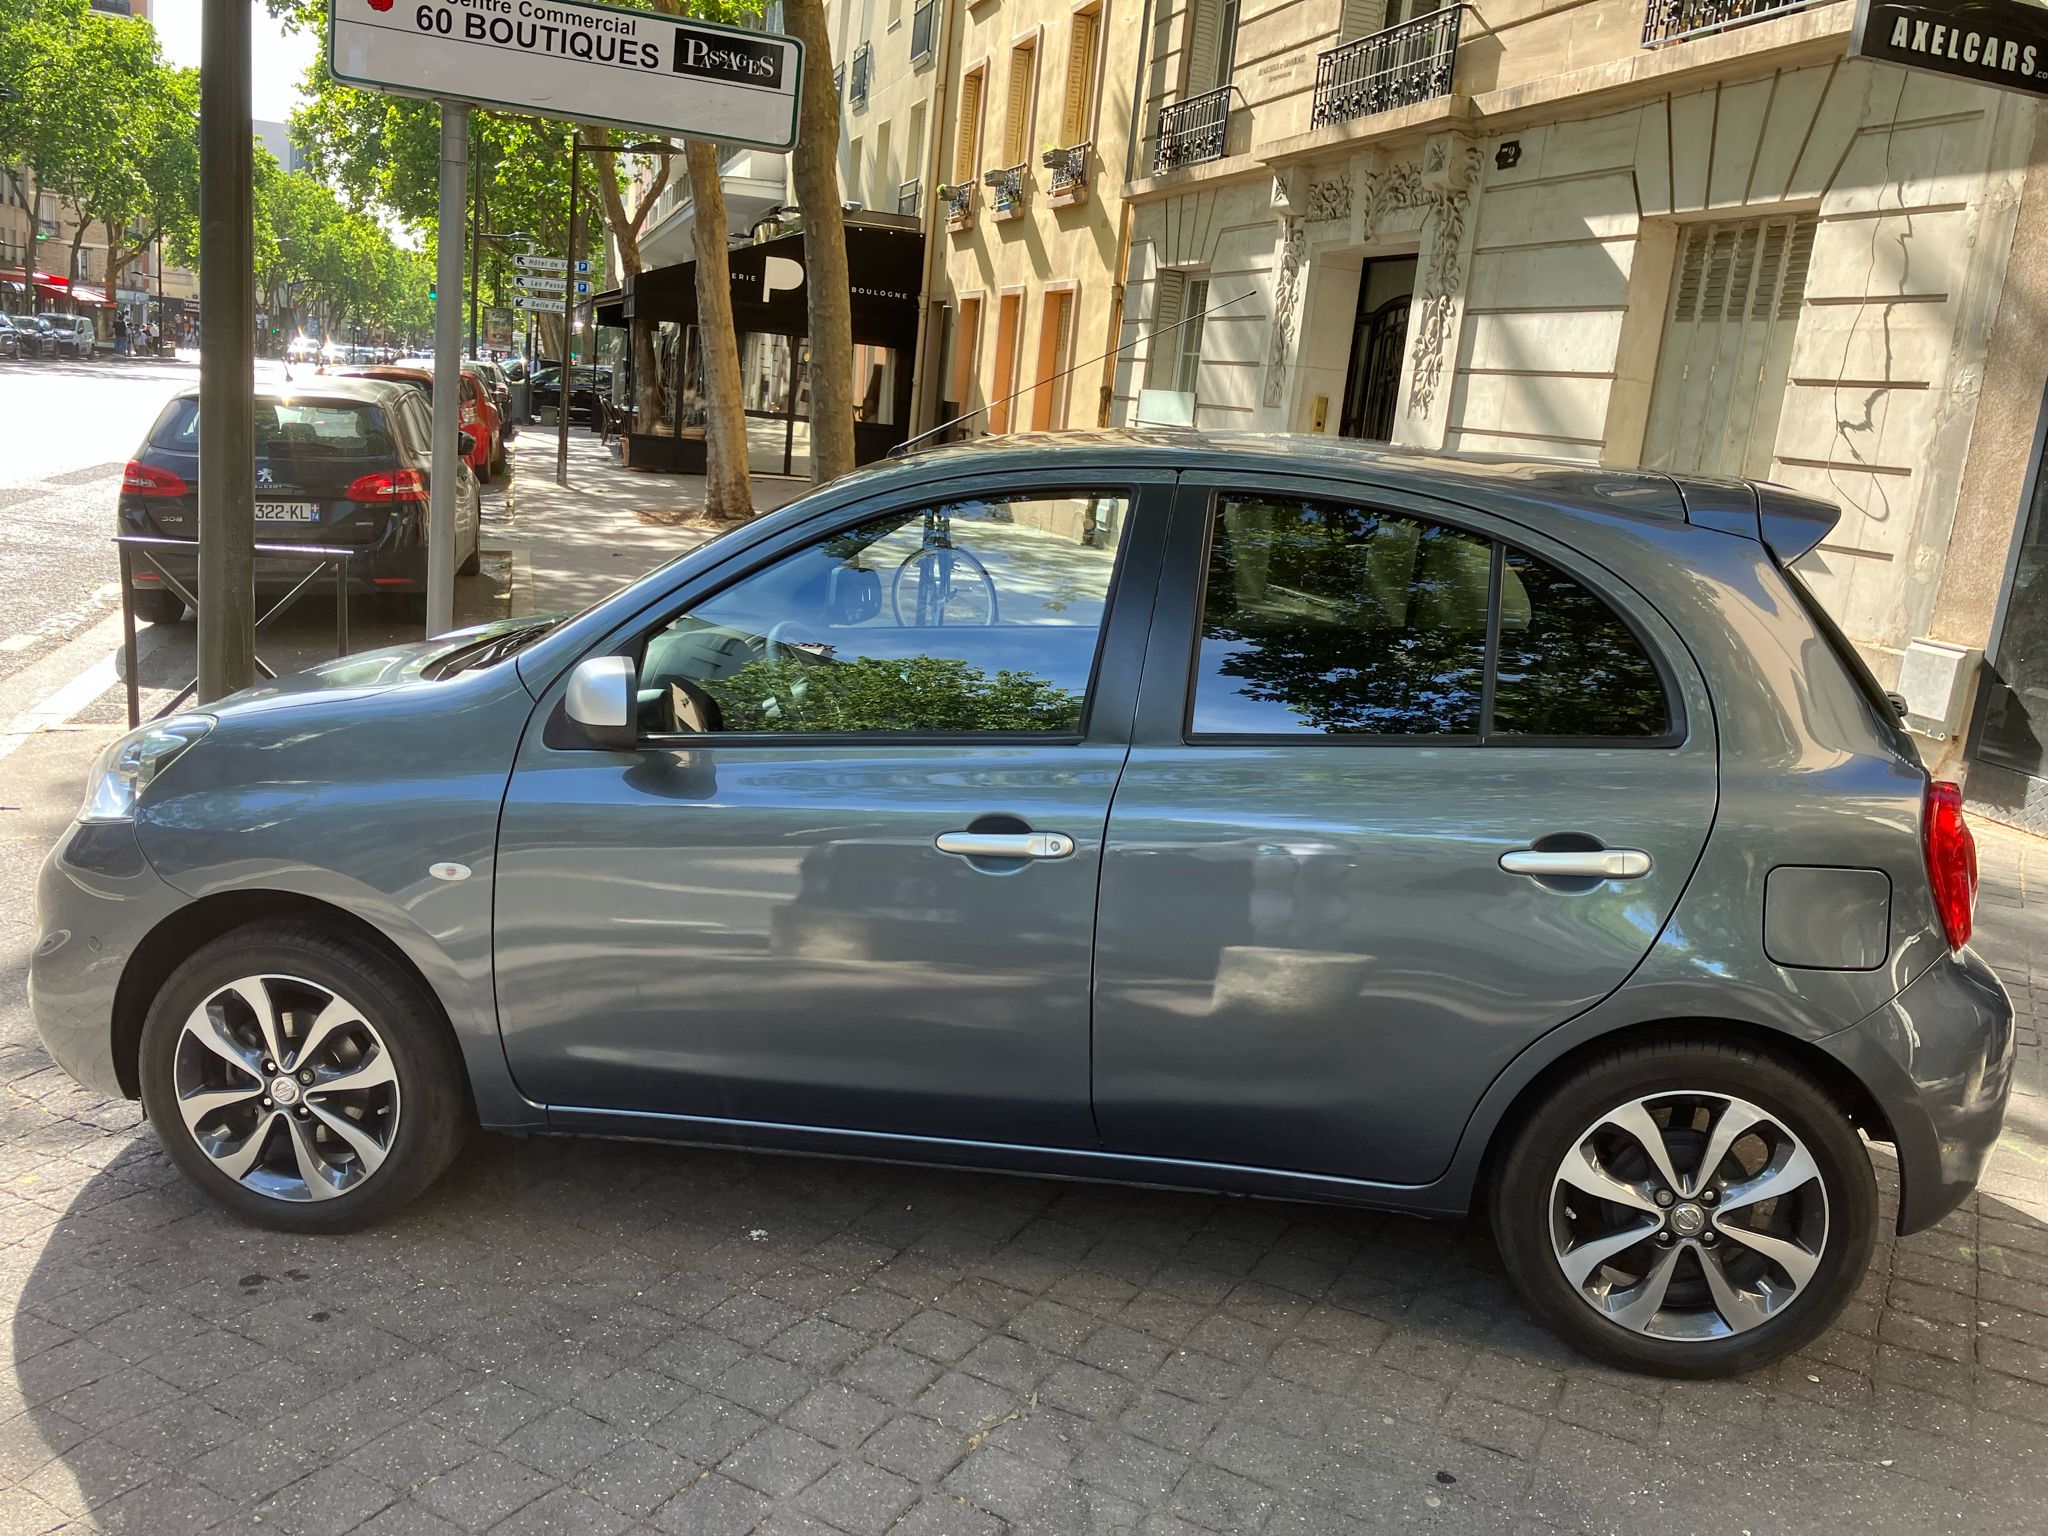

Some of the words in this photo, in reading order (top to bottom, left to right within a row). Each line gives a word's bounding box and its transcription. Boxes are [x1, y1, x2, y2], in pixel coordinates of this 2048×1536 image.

[446, 0, 512, 14] entre
[518, 1, 636, 36] Commercial
[415, 5, 453, 34] 60
[465, 12, 659, 69] BOUTIQUES
[1890, 16, 2038, 76] AXELCARS
[731, 272, 756, 282] ERIE
[851, 286, 908, 300] BOULOGNE
[255, 504, 310, 520] 322-KL
